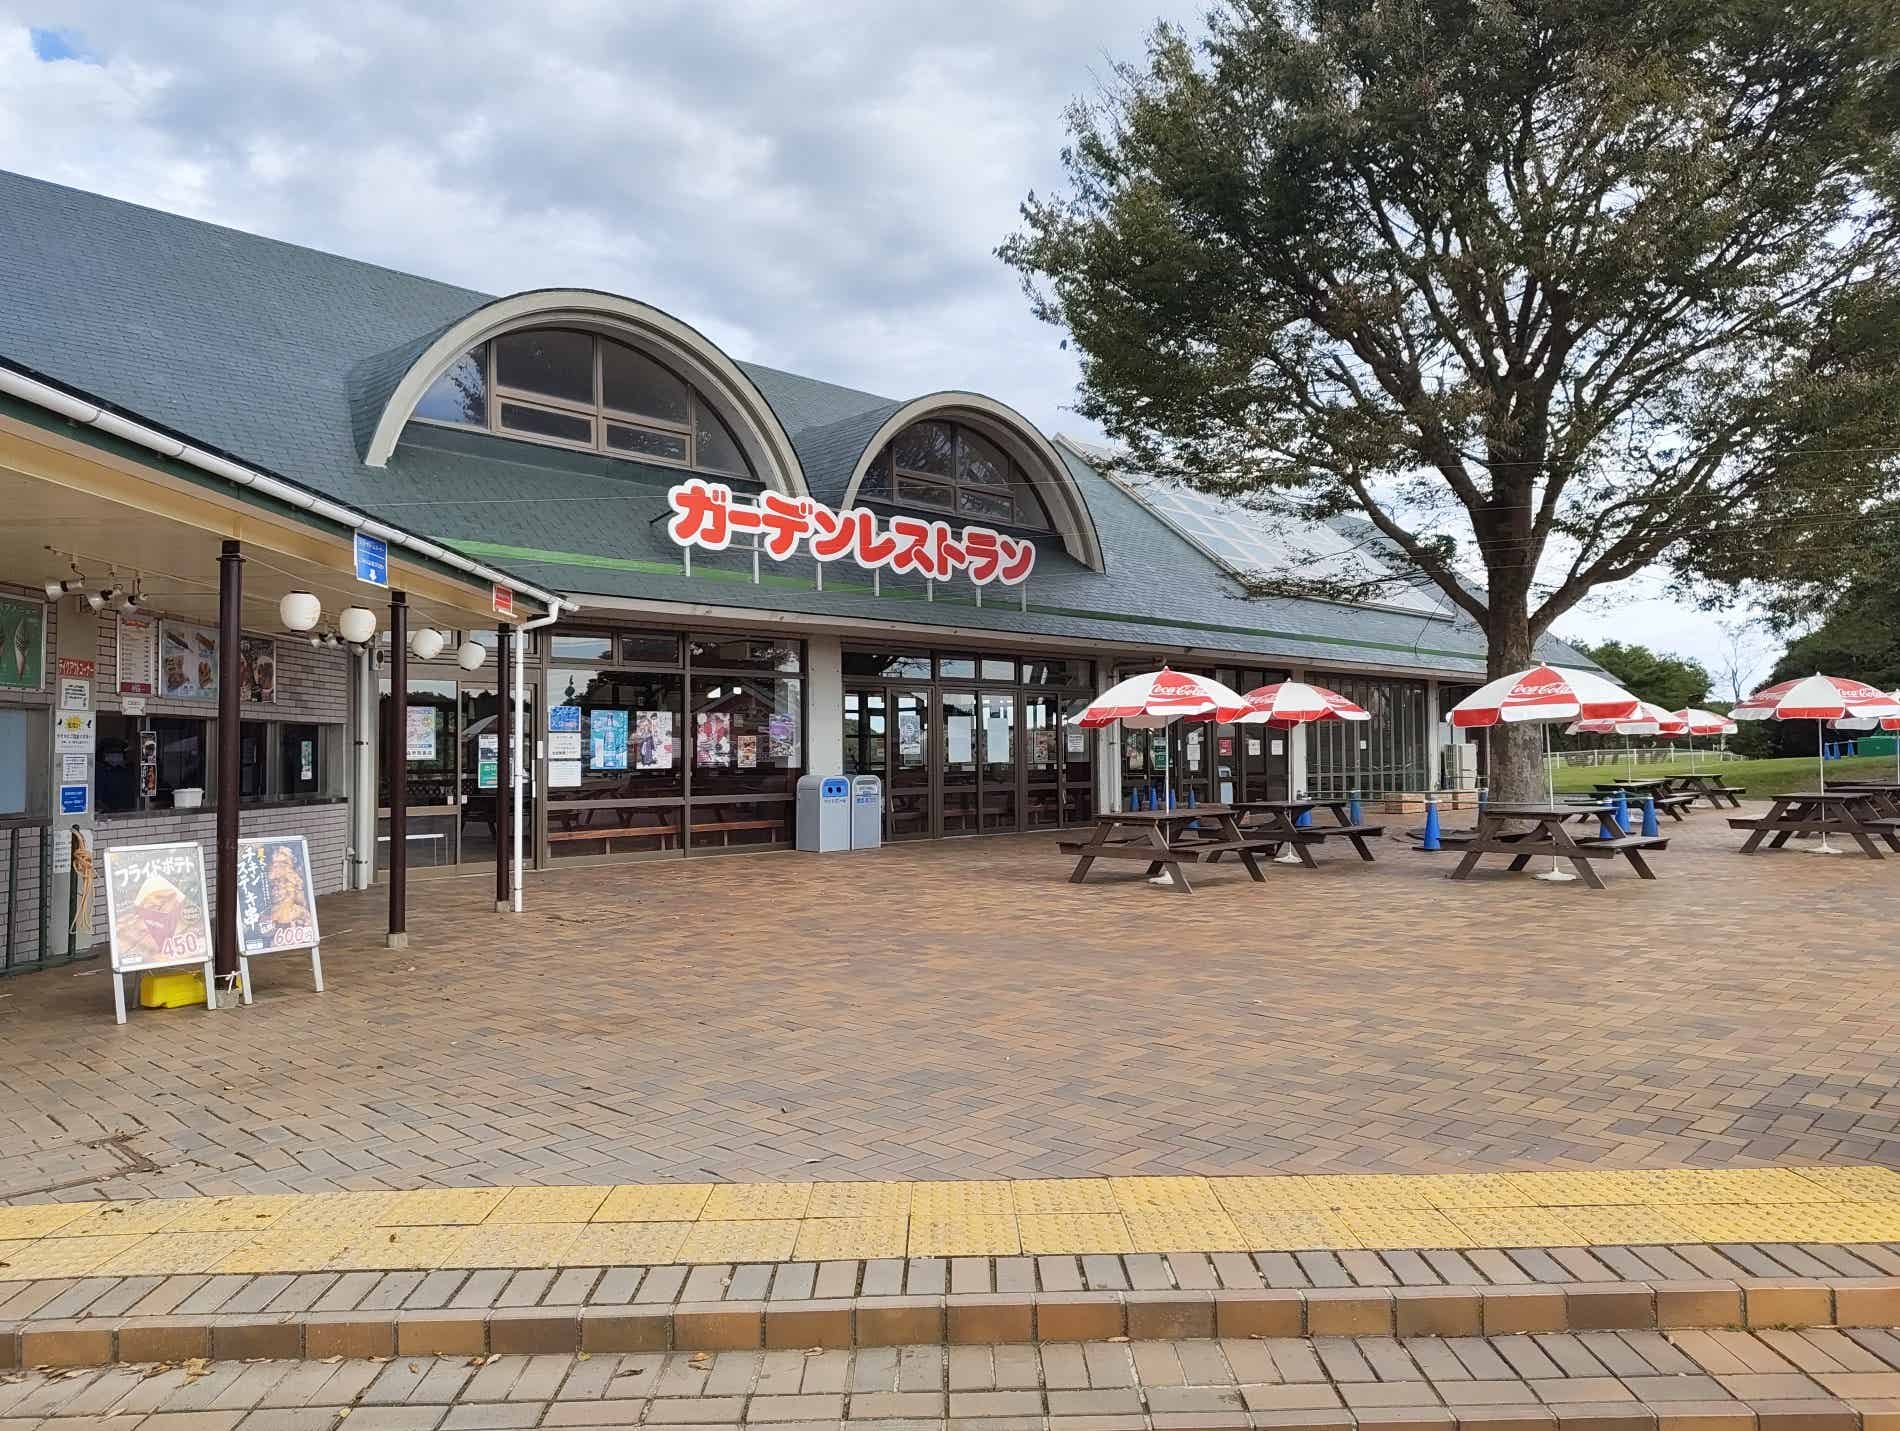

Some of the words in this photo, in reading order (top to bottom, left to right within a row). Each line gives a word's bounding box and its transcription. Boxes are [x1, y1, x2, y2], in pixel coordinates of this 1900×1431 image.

[670, 481, 1034, 584] ガーデンレストラン
[1151, 684, 1208, 697] Coca-Cola
[1507, 682, 1576, 696] Coca-Cola
[1838, 687, 1886, 698] Coca-Cola
[114, 856, 195, 887] フライドポテト
